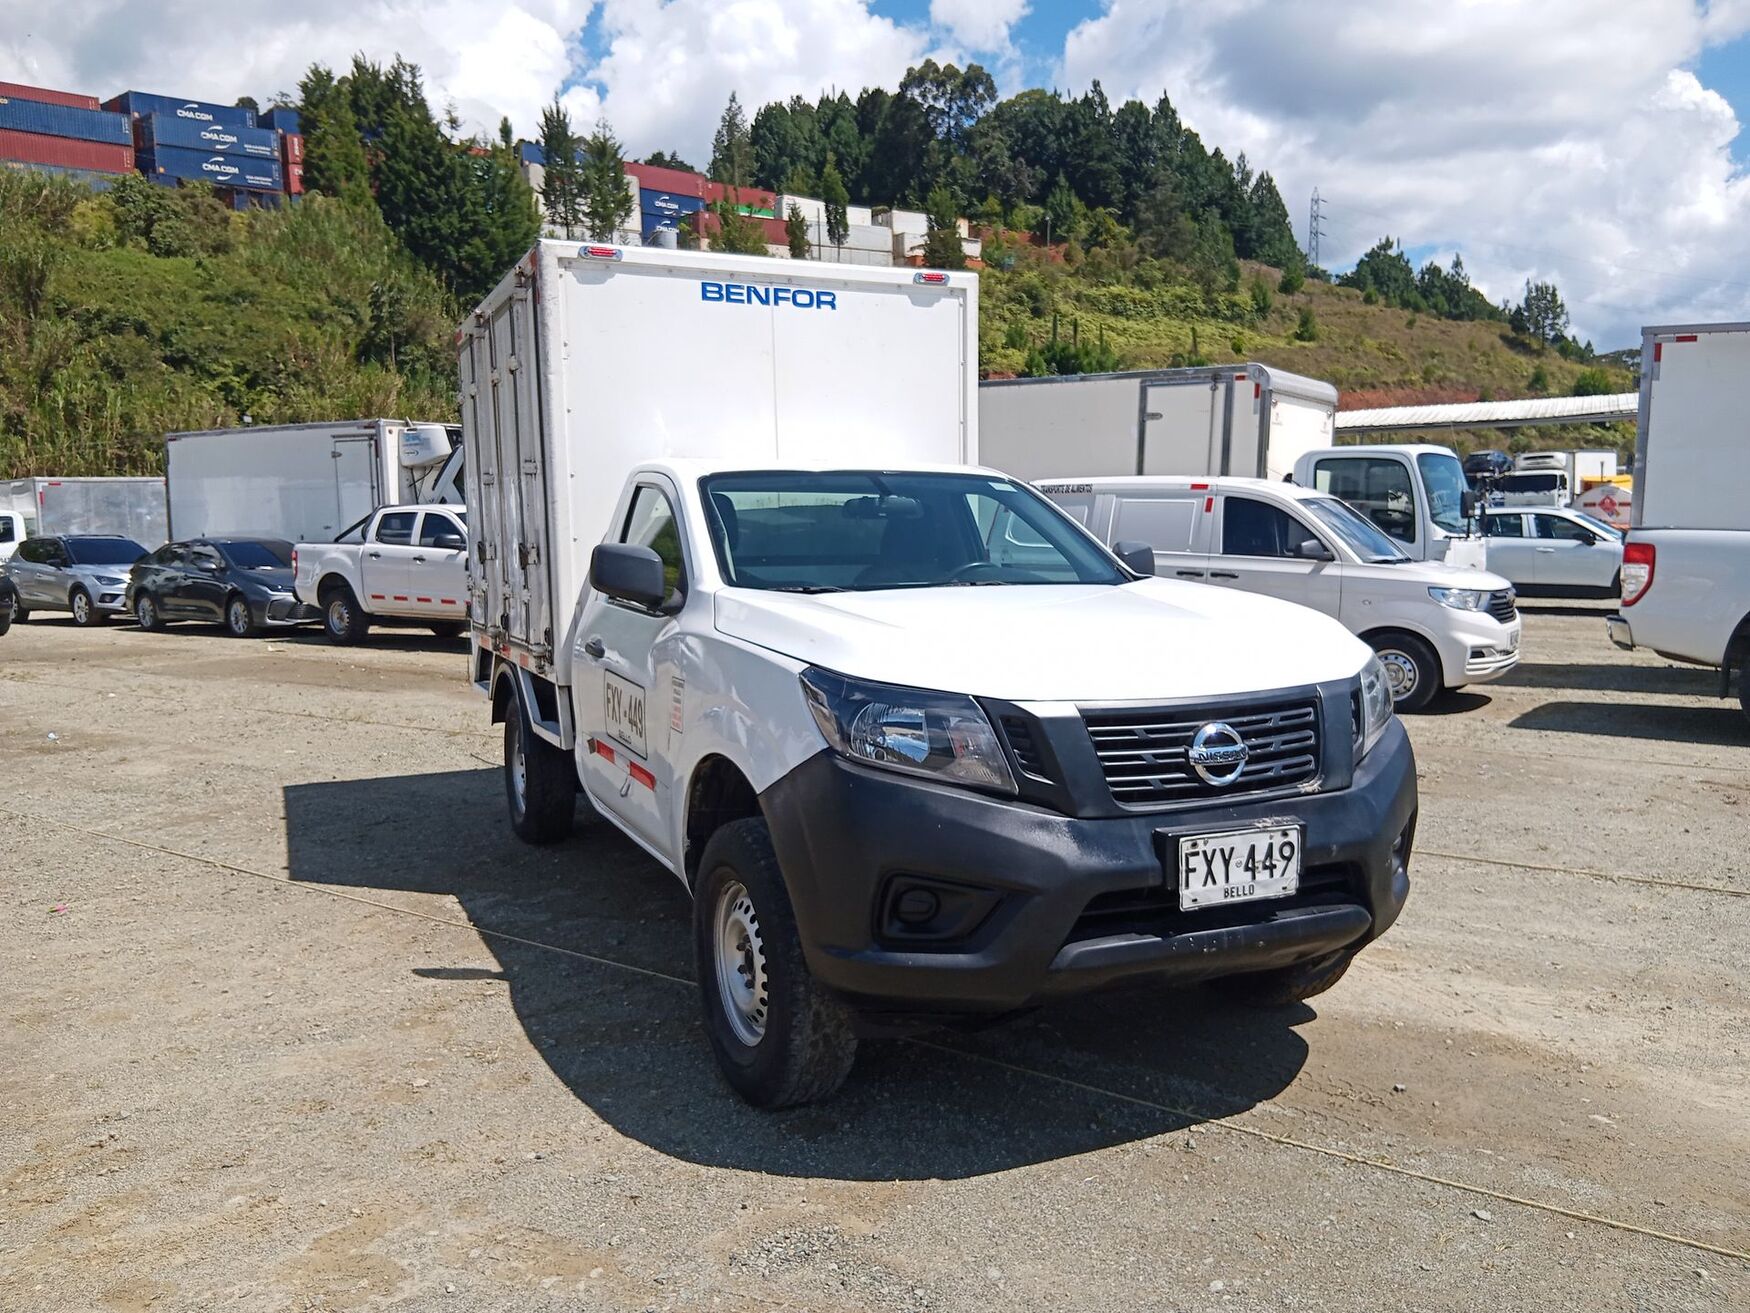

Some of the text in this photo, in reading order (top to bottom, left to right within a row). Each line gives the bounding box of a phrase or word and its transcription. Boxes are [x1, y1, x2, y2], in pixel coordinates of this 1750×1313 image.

[176, 109, 195, 119] CMA
[200, 131, 219, 141] CMA
[202, 163, 220, 172] CMA
[701, 281, 837, 311] BENFOR
[606, 682, 622, 724] FXY
[628, 694, 643, 738] 449
[1199, 748, 1246, 762] NISSAN
[1185, 840, 1295, 890] FXY 449
[1223, 884, 1255, 899] BELLO
